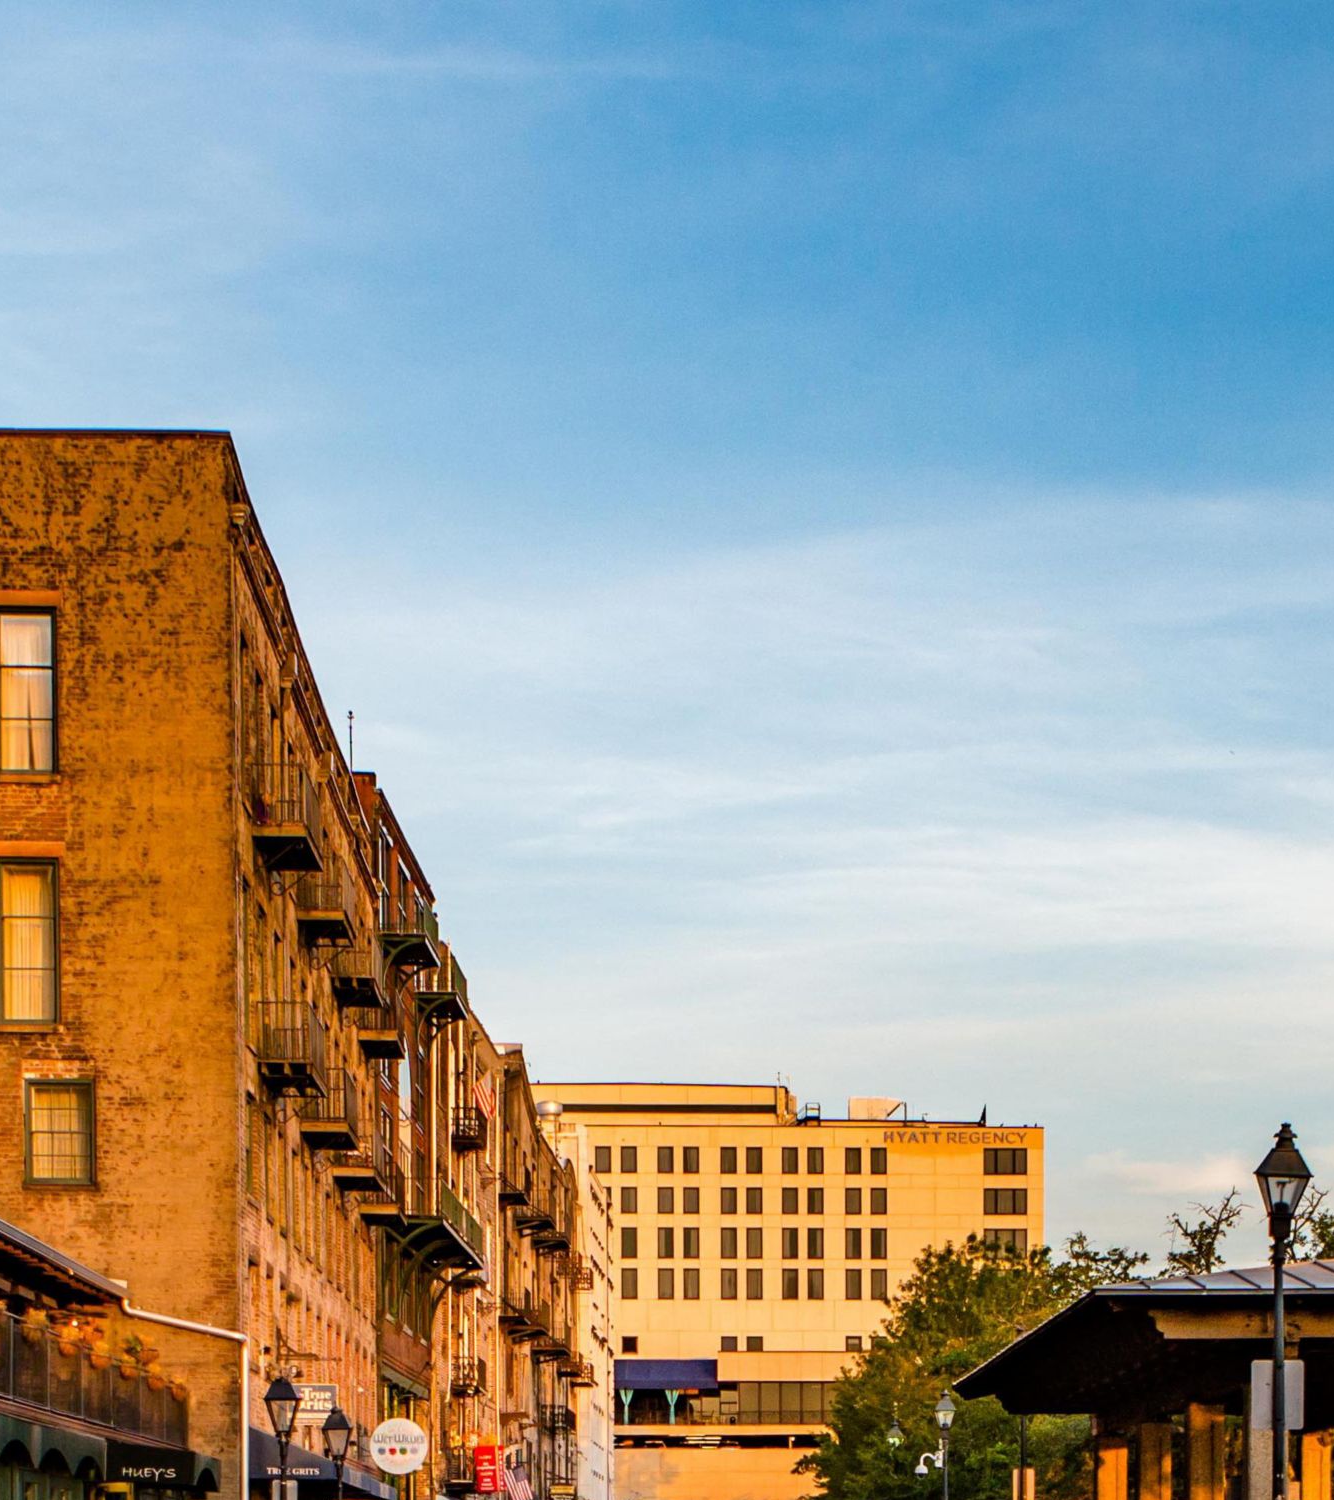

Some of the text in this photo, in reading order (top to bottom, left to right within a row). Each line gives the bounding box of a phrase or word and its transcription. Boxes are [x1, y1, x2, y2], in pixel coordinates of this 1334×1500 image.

[883, 1131, 1027, 1145] HYATT REGENCY
[299, 1387, 331, 1401] True
[300, 1398, 333, 1410] rits
[122, 1467, 177, 1483] HUEY'S
[292, 1467, 320, 1476] GRITS
